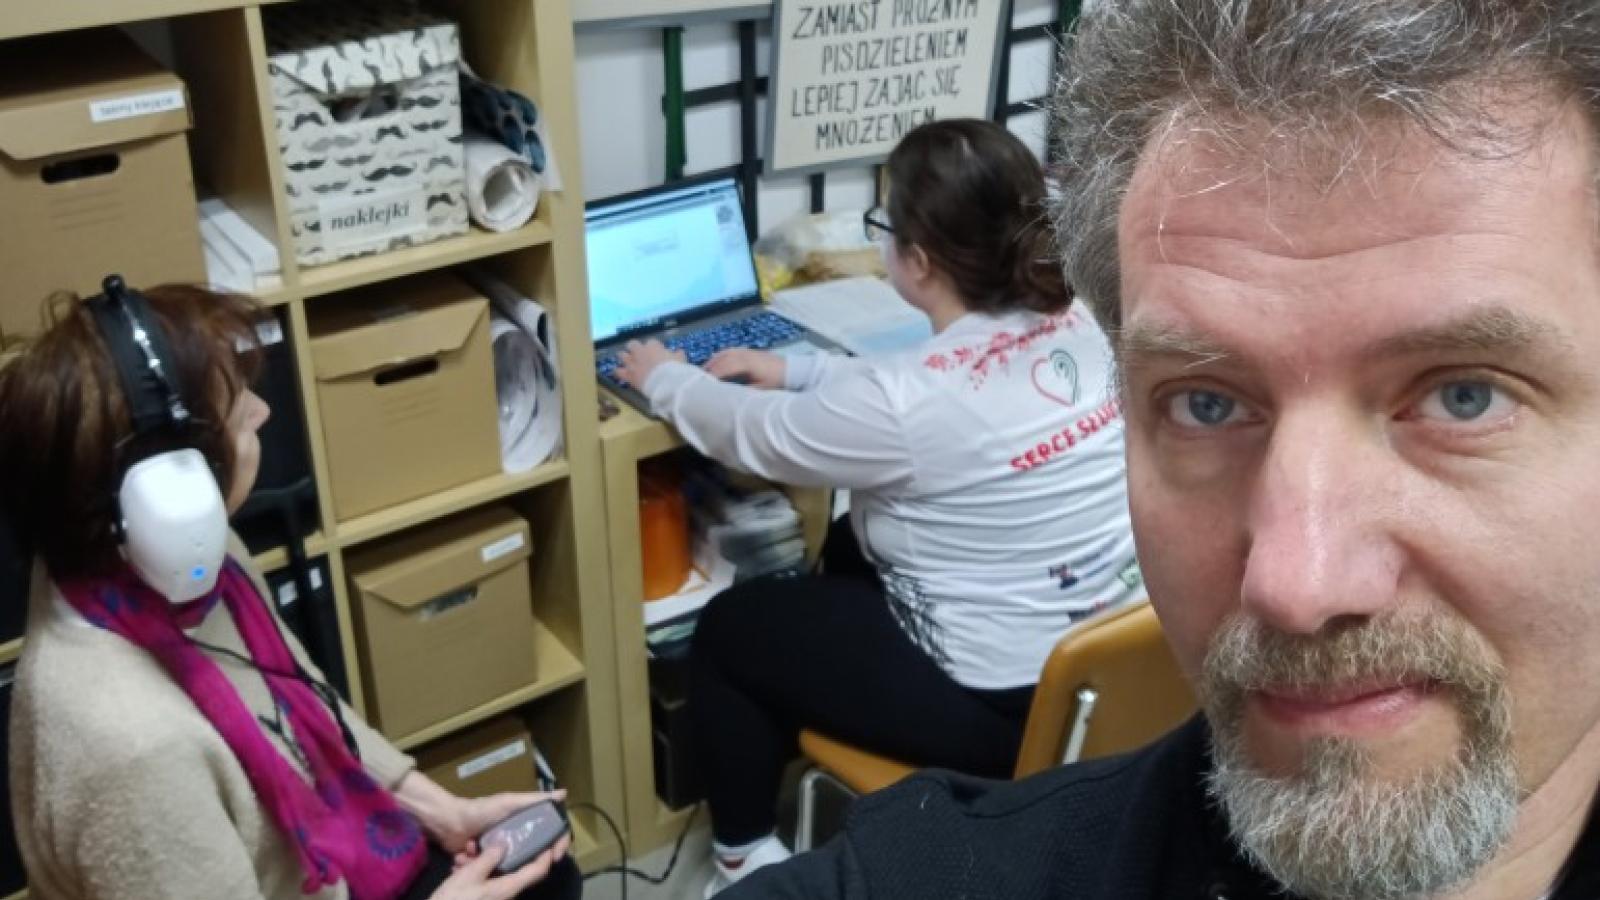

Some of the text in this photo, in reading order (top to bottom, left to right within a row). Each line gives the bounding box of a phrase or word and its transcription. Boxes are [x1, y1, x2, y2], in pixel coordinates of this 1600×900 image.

[792, 0, 881, 39] ZAMIAST
[791, 81, 859, 117] LEPIEJ
[330, 199, 410, 232] naklejki
